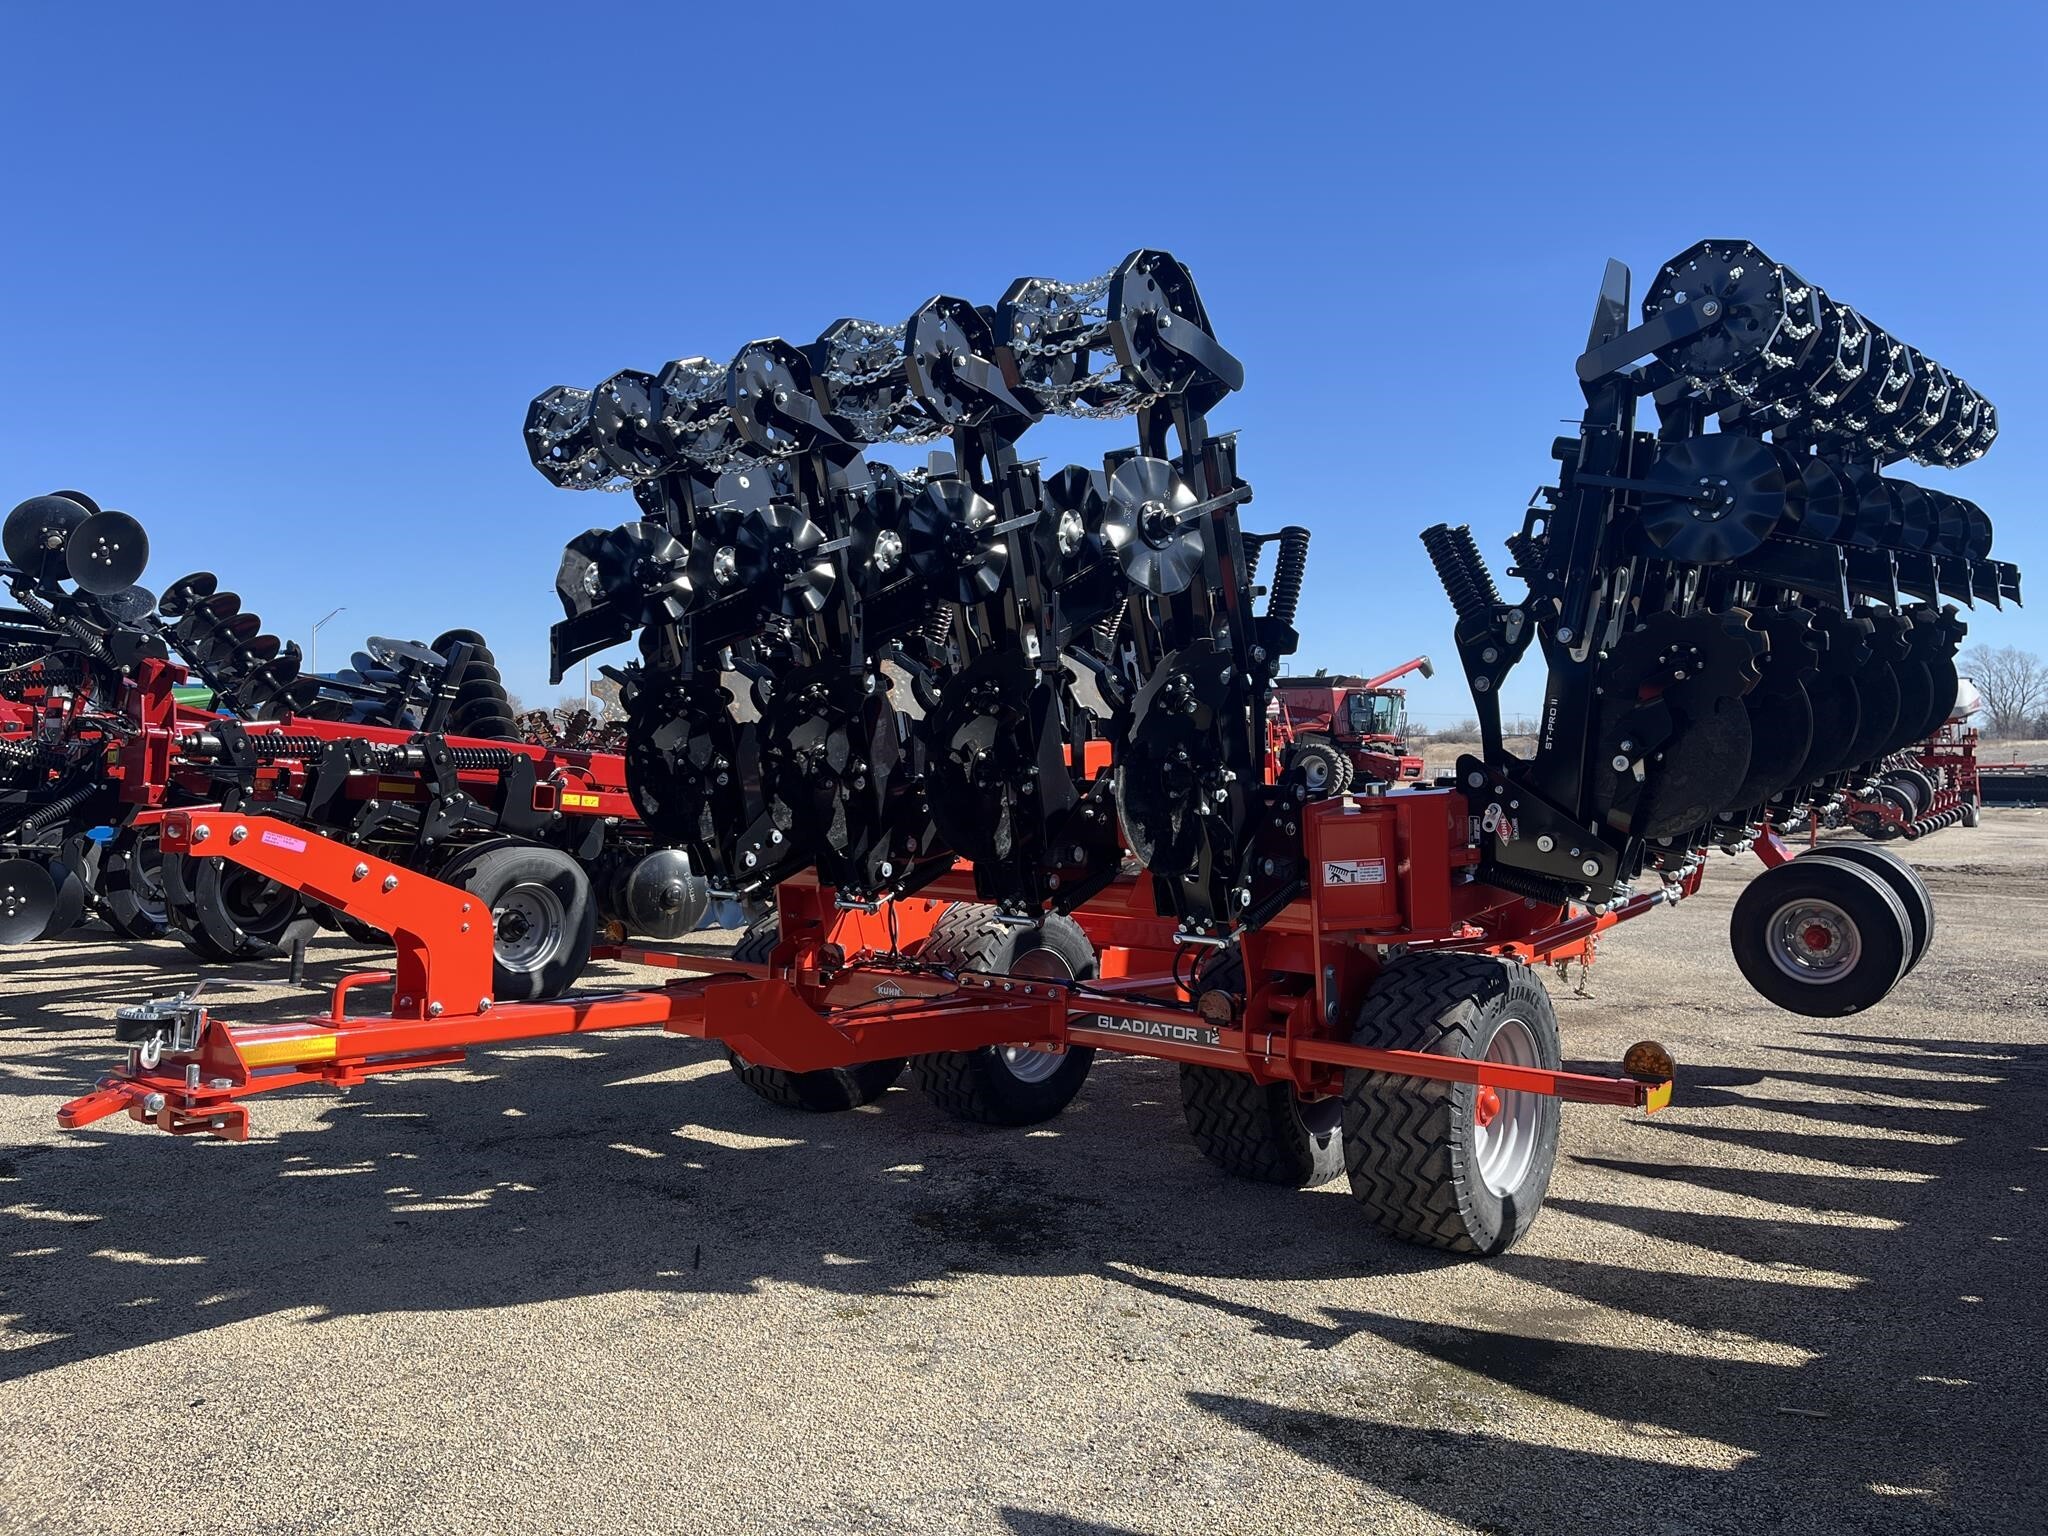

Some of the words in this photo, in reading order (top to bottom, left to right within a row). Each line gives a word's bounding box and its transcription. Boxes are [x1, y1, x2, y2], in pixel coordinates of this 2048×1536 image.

[1545, 708, 1557, 750] ST-PRO
[1501, 818, 1509, 840] KUHN
[878, 986, 901, 996] KUHN
[1498, 987, 1541, 1014] ALLIANCE
[1097, 1015, 1198, 1042] GLADIATOR
